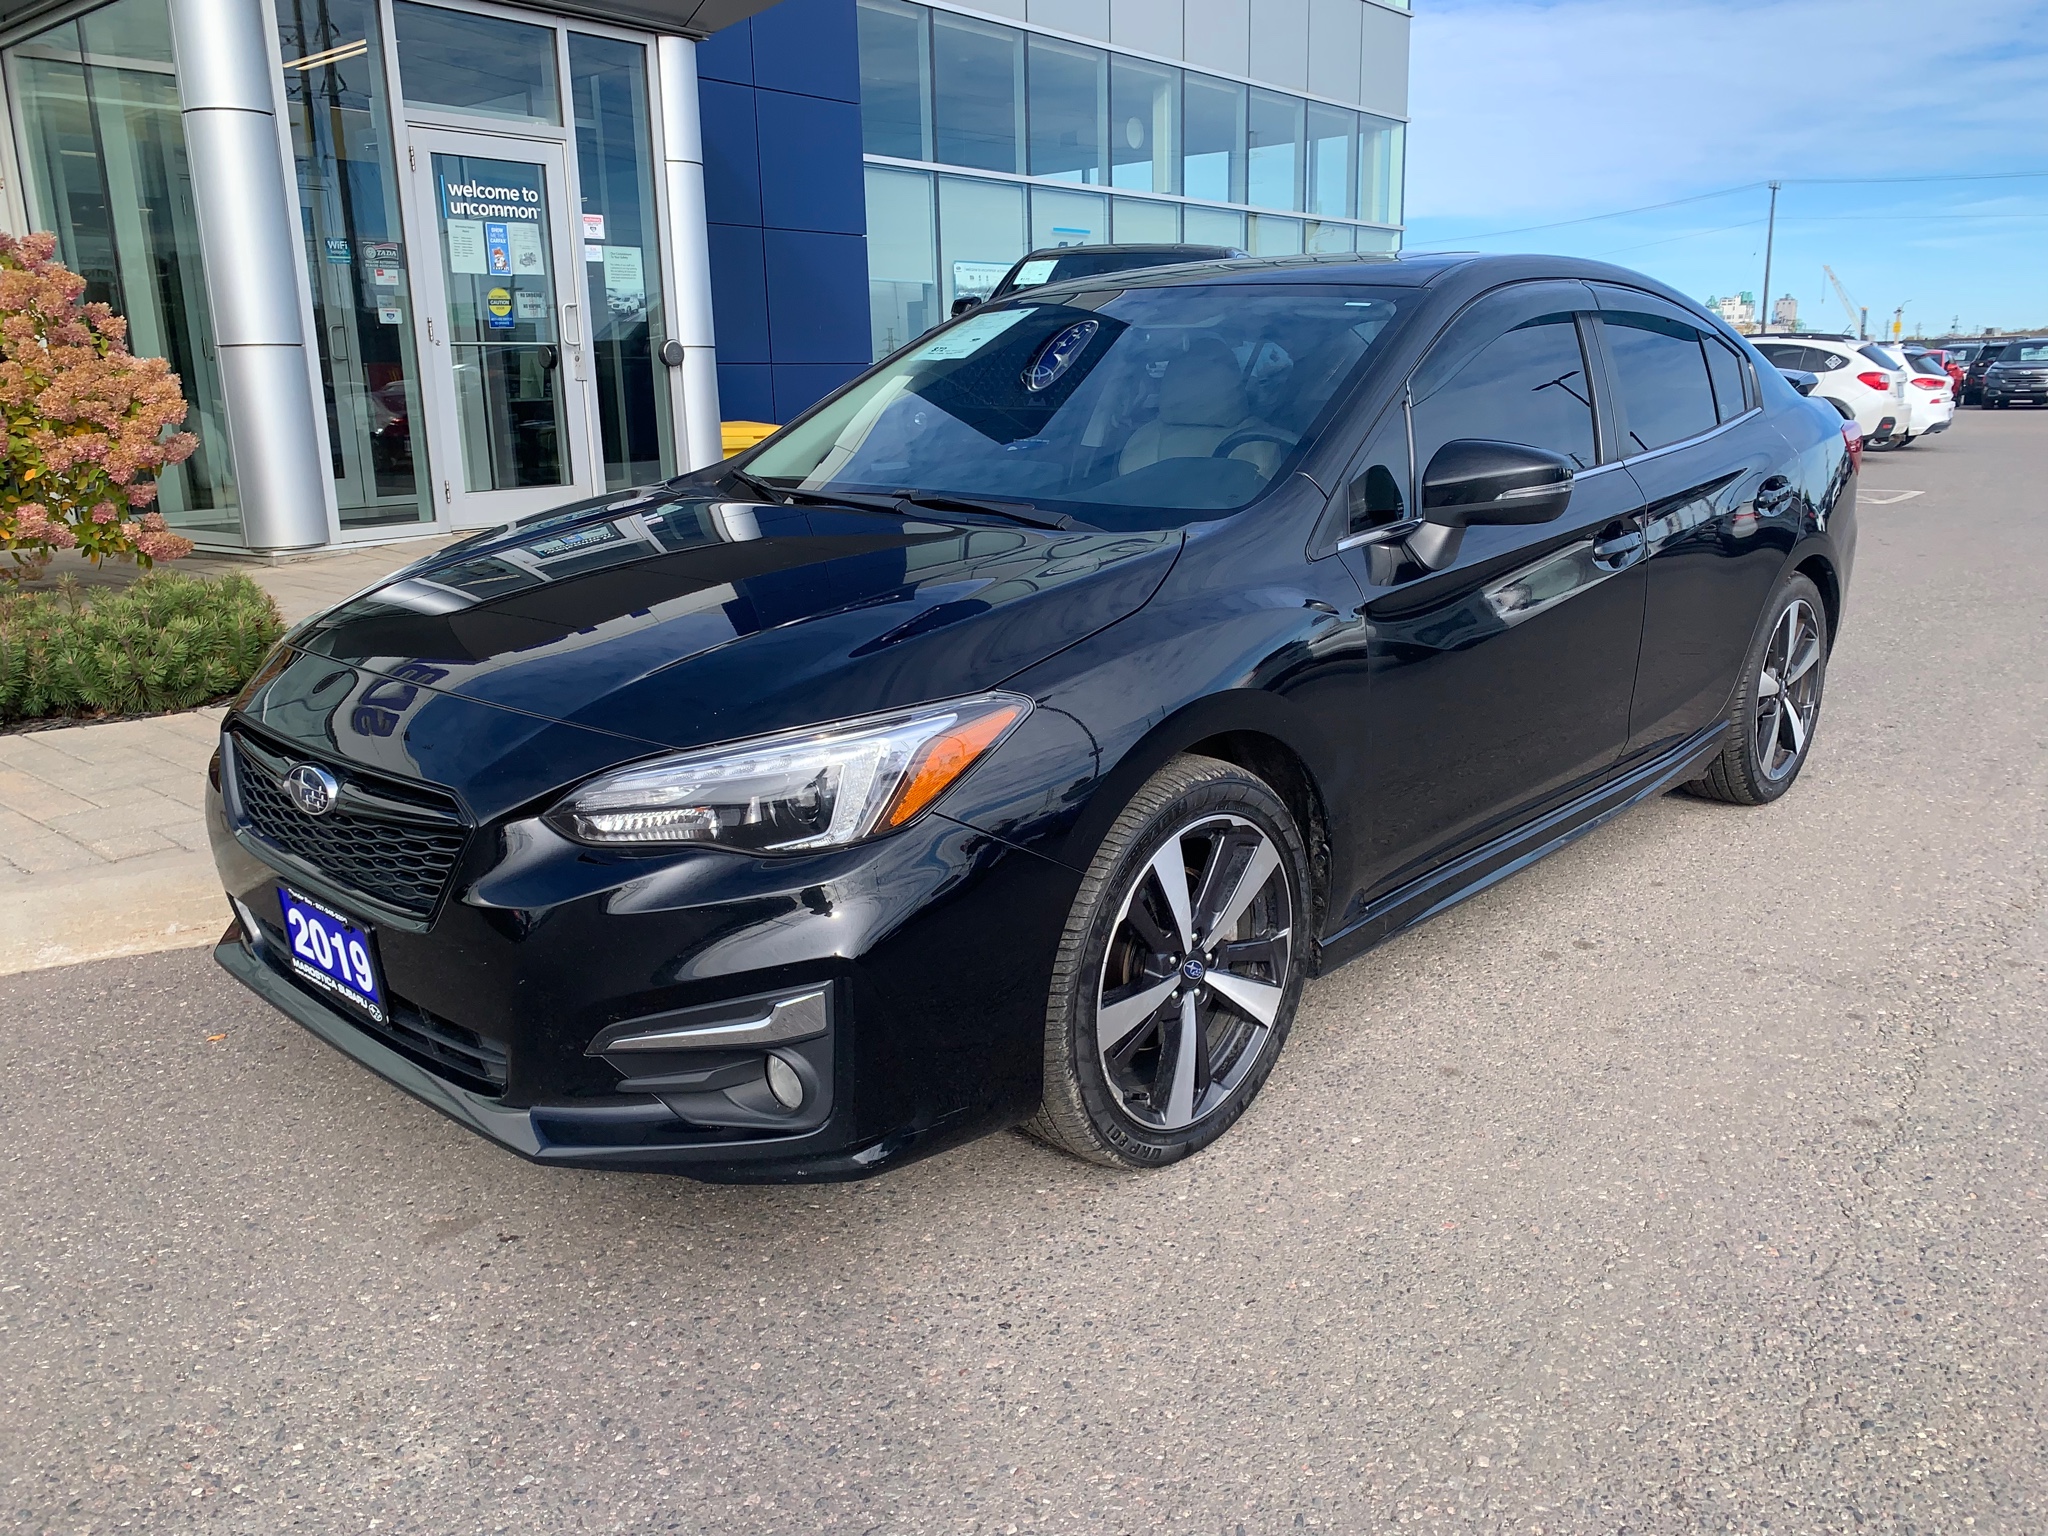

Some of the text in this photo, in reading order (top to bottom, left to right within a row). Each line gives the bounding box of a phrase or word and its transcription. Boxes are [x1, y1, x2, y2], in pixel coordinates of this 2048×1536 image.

[447, 180, 538, 203] welcome to
[327, 240, 348, 250] WiFi
[288, 907, 373, 992] 2019
[292, 957, 338, 991] MAROSTICA
[337, 984, 368, 1009] SUBARU
